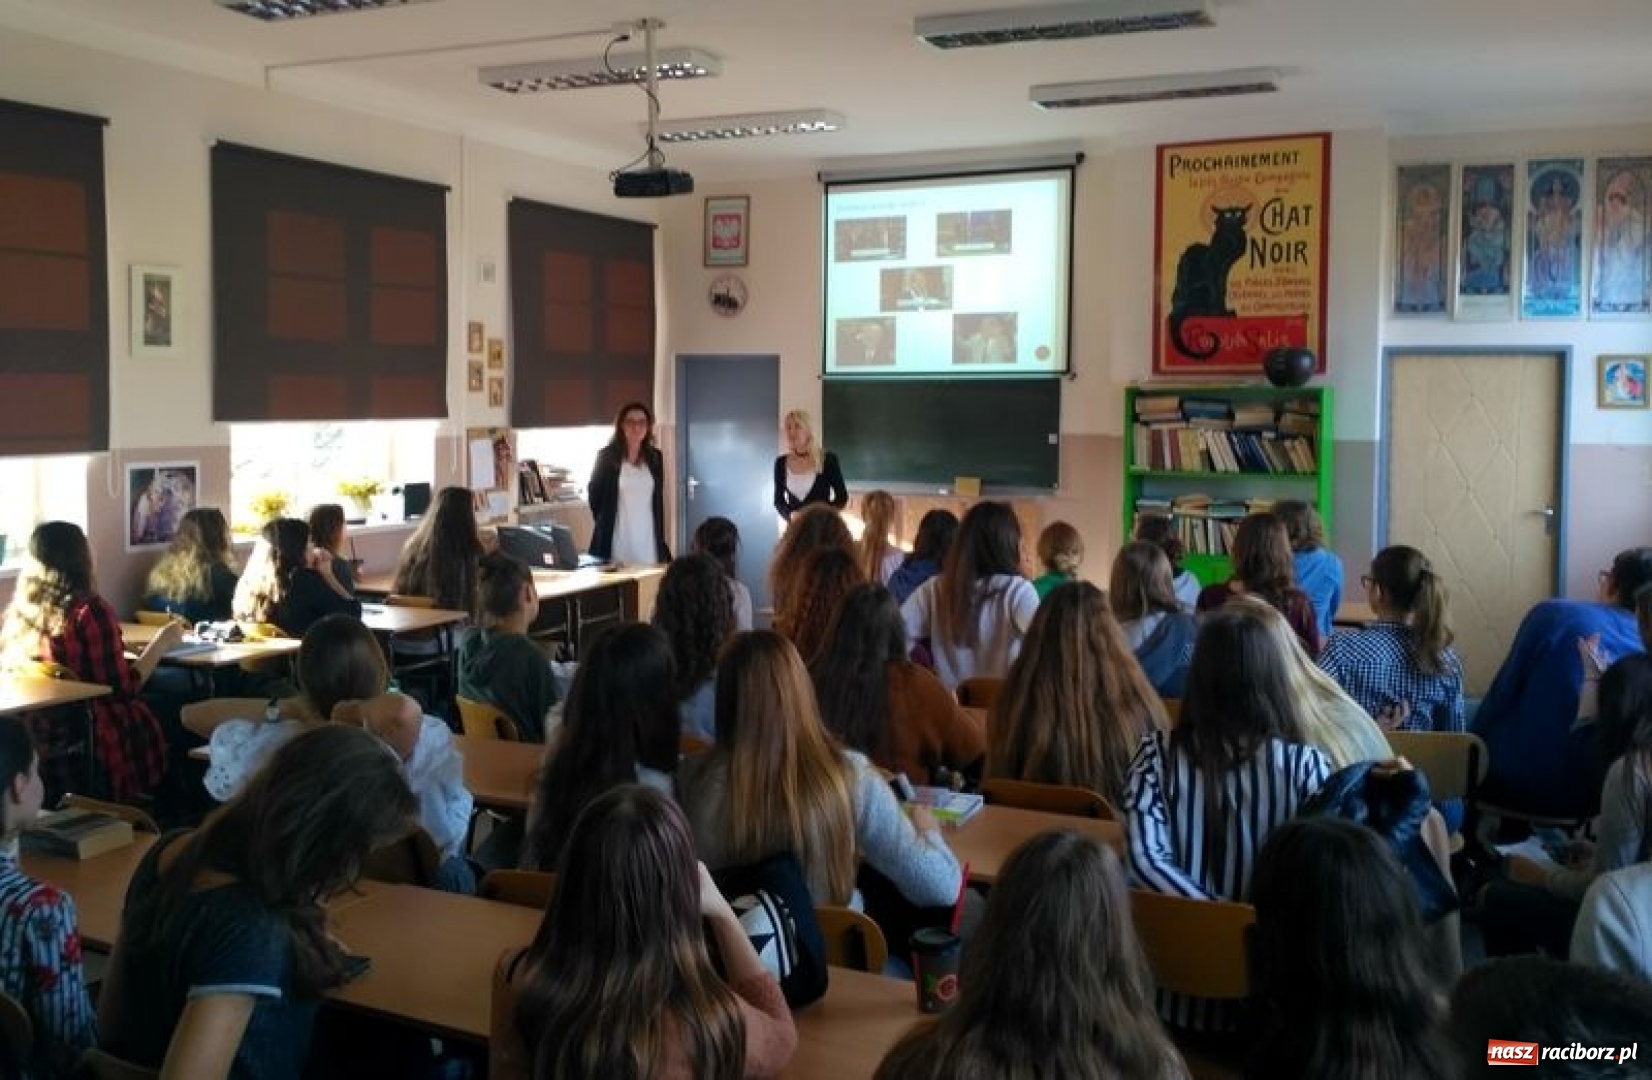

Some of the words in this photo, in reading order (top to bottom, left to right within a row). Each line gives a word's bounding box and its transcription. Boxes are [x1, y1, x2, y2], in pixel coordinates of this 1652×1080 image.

[1170, 151, 1299, 177] PROCHAINEMENT
[1260, 198, 1312, 235] CHAT
[1250, 237, 1308, 269] NOIR
